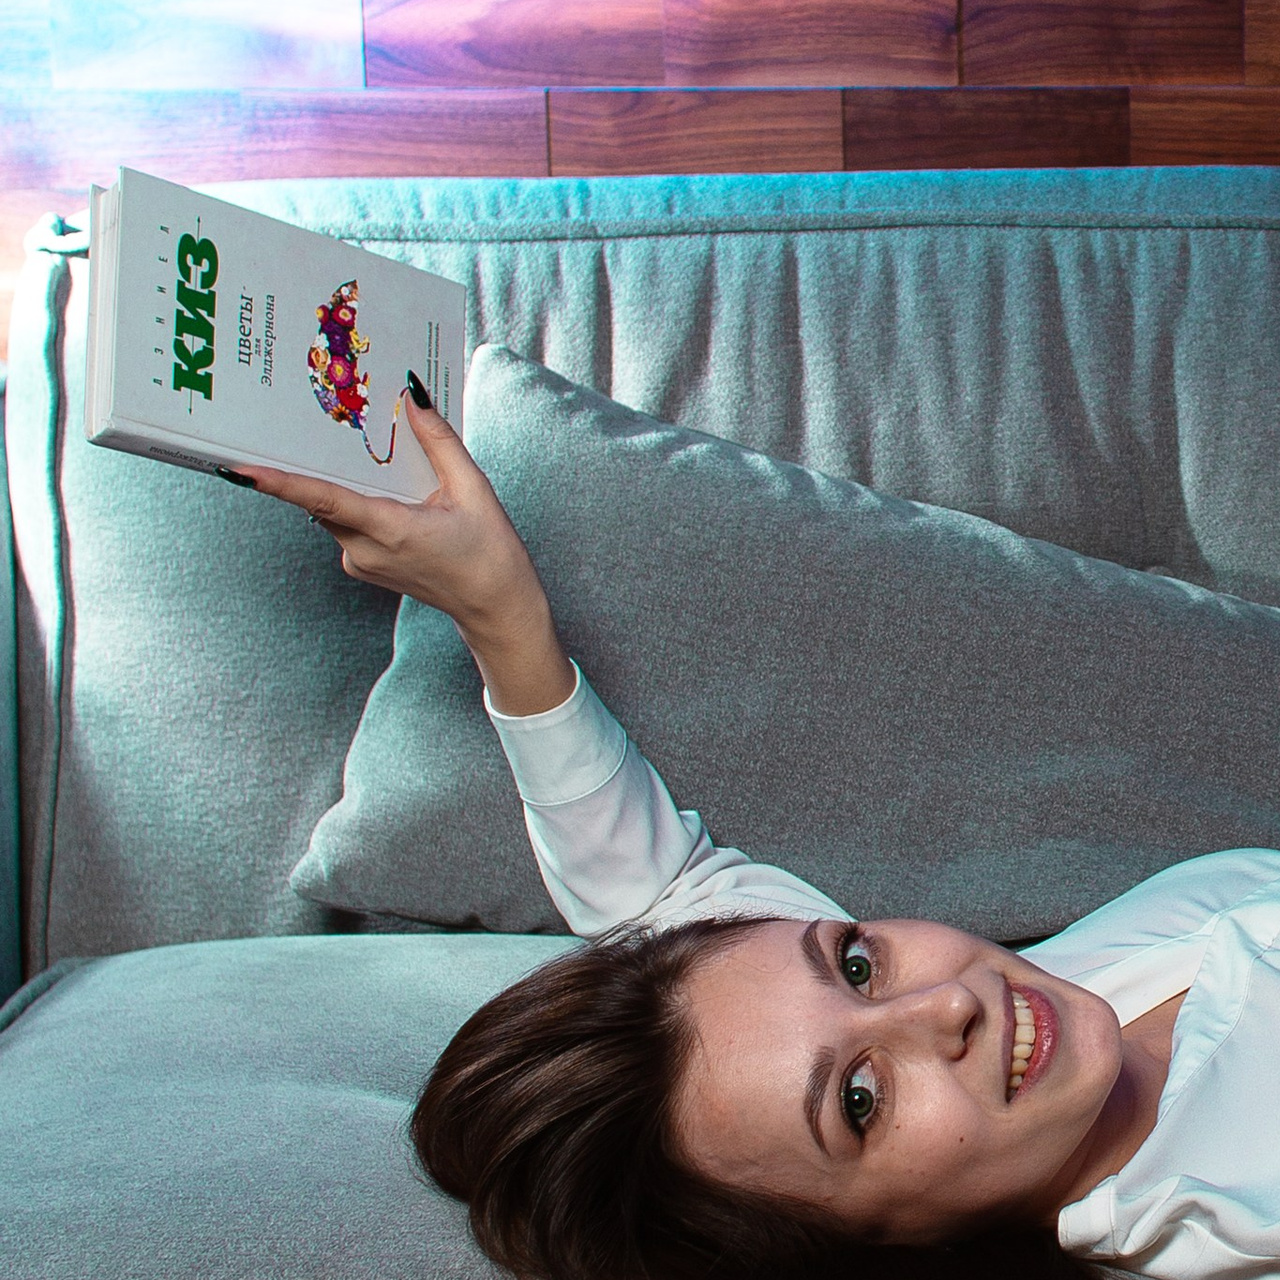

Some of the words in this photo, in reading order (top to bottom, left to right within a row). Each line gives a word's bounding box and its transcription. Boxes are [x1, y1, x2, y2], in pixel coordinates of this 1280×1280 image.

[153, 225, 169, 386] ДЭНИЕЛ
[173, 233, 219, 401] КИЗ
[261, 294, 276, 387] Элджернона
